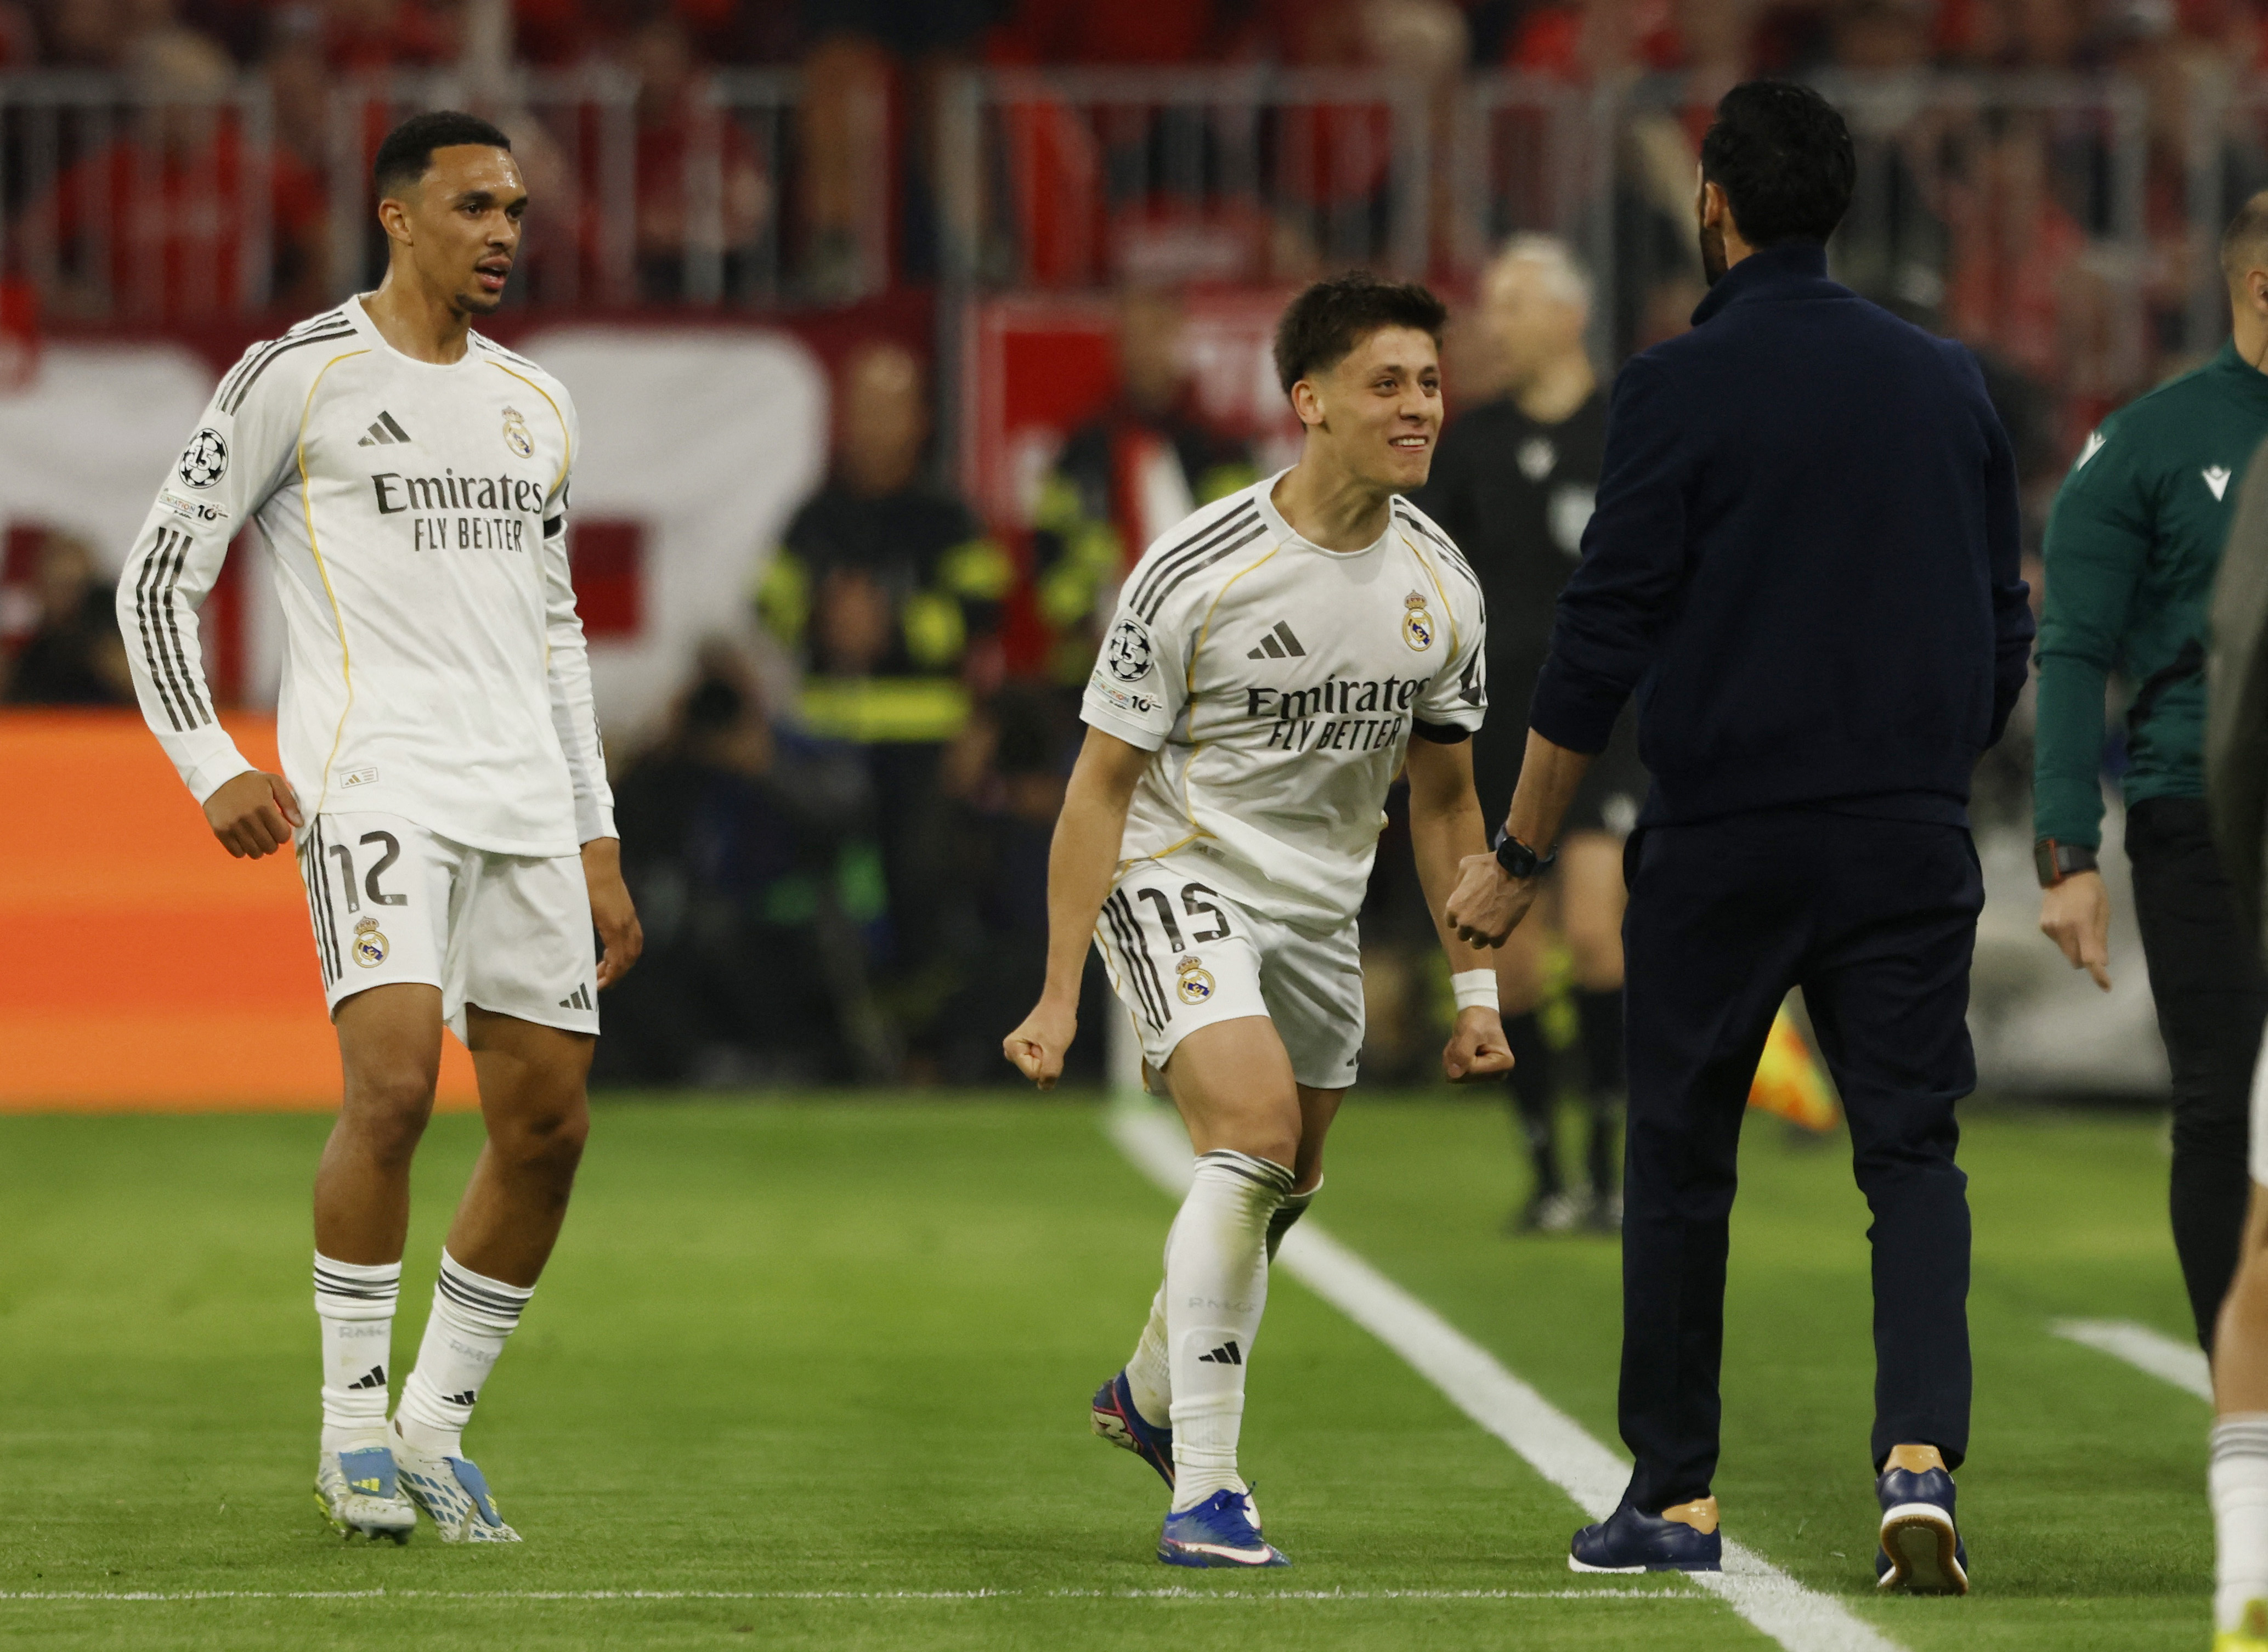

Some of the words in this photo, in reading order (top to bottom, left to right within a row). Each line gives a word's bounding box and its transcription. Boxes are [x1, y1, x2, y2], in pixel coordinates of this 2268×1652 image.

[189, 446, 214, 471] 15
[371, 468, 542, 514] Emirates
[414, 518, 446, 551] FLY
[457, 518, 522, 552] BETTER
[1115, 636, 1139, 664] 15
[1268, 720, 1315, 753] FLY
[1315, 717, 1402, 751] BETTER
[330, 830, 409, 914] 12
[1138, 882, 1231, 953] 15
